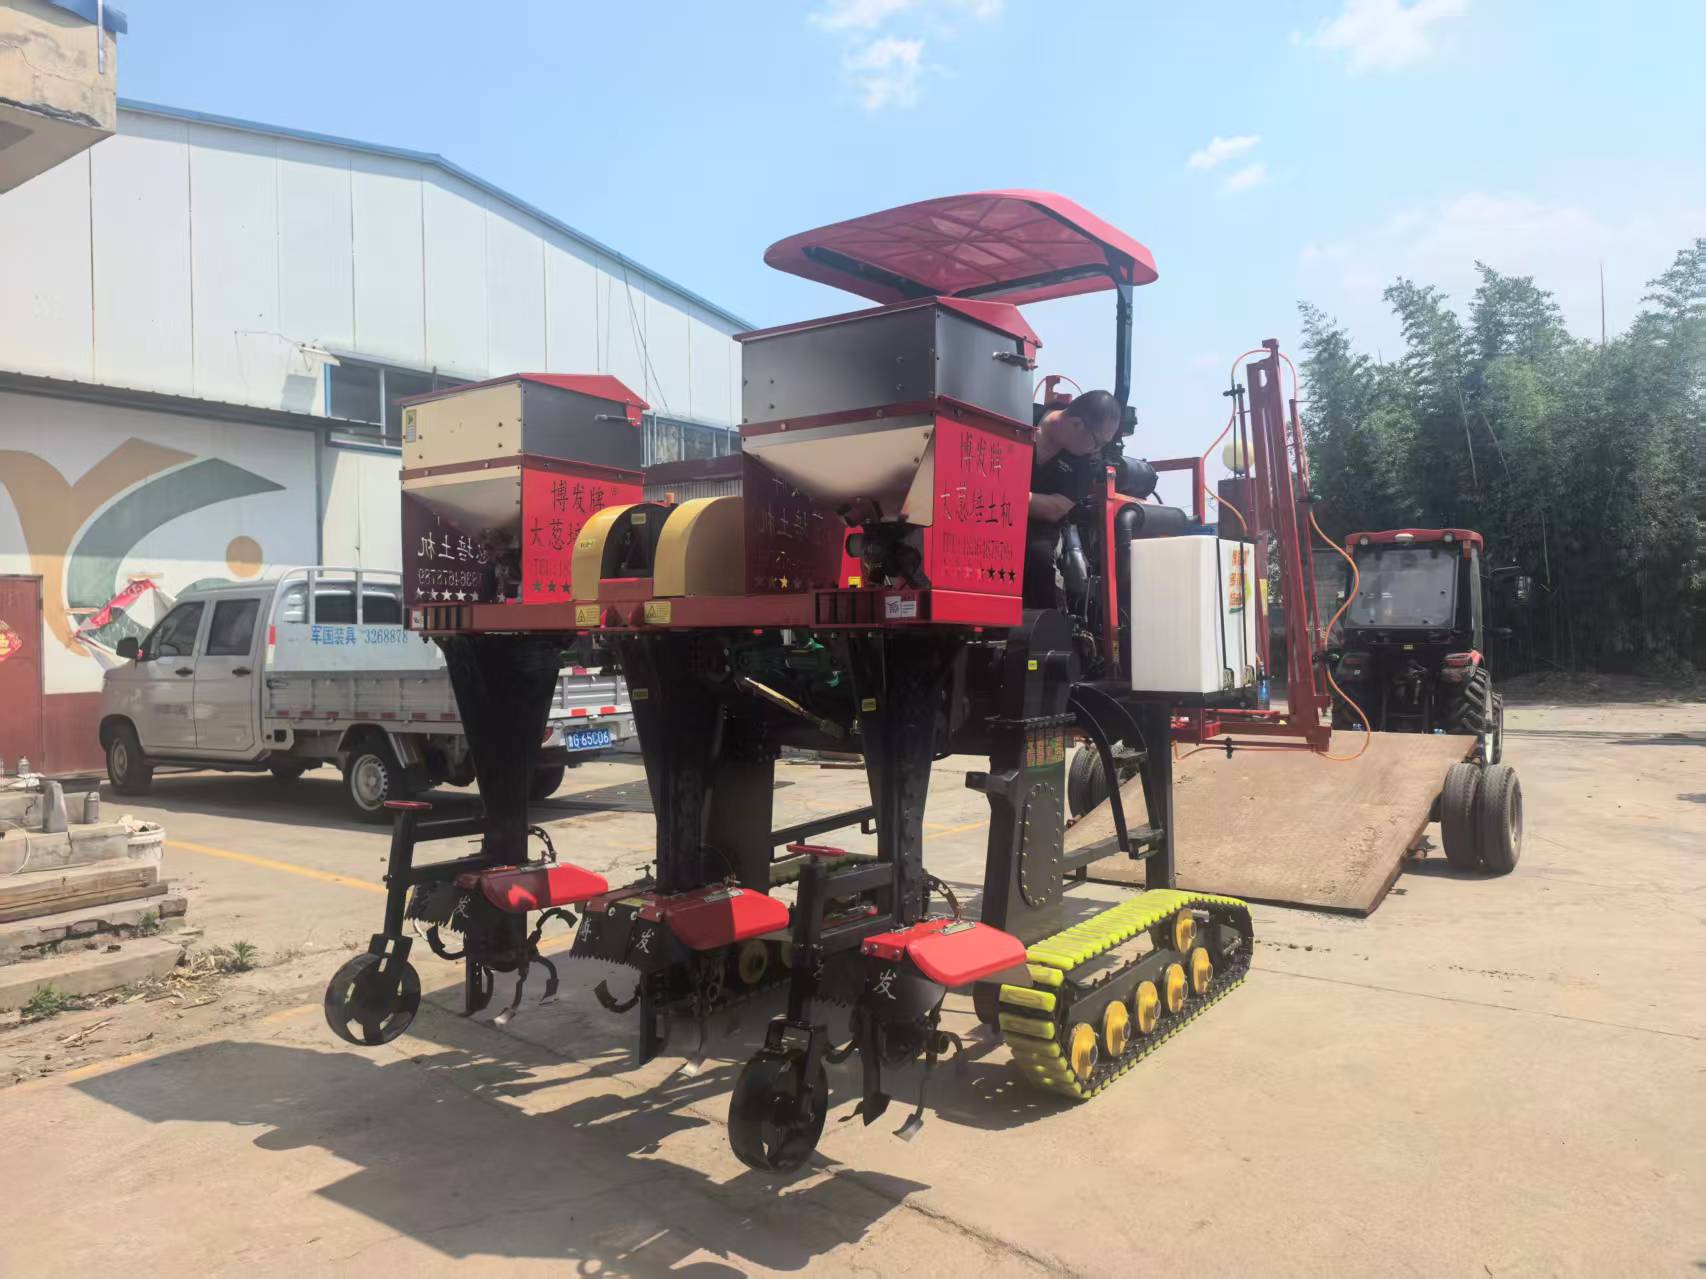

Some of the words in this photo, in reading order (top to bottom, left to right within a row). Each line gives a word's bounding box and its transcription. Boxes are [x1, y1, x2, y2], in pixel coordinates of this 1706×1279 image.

[551, 480, 605, 512] 博发牌
[635, 928, 655, 954] 发
[872, 968, 897, 1000] 发
